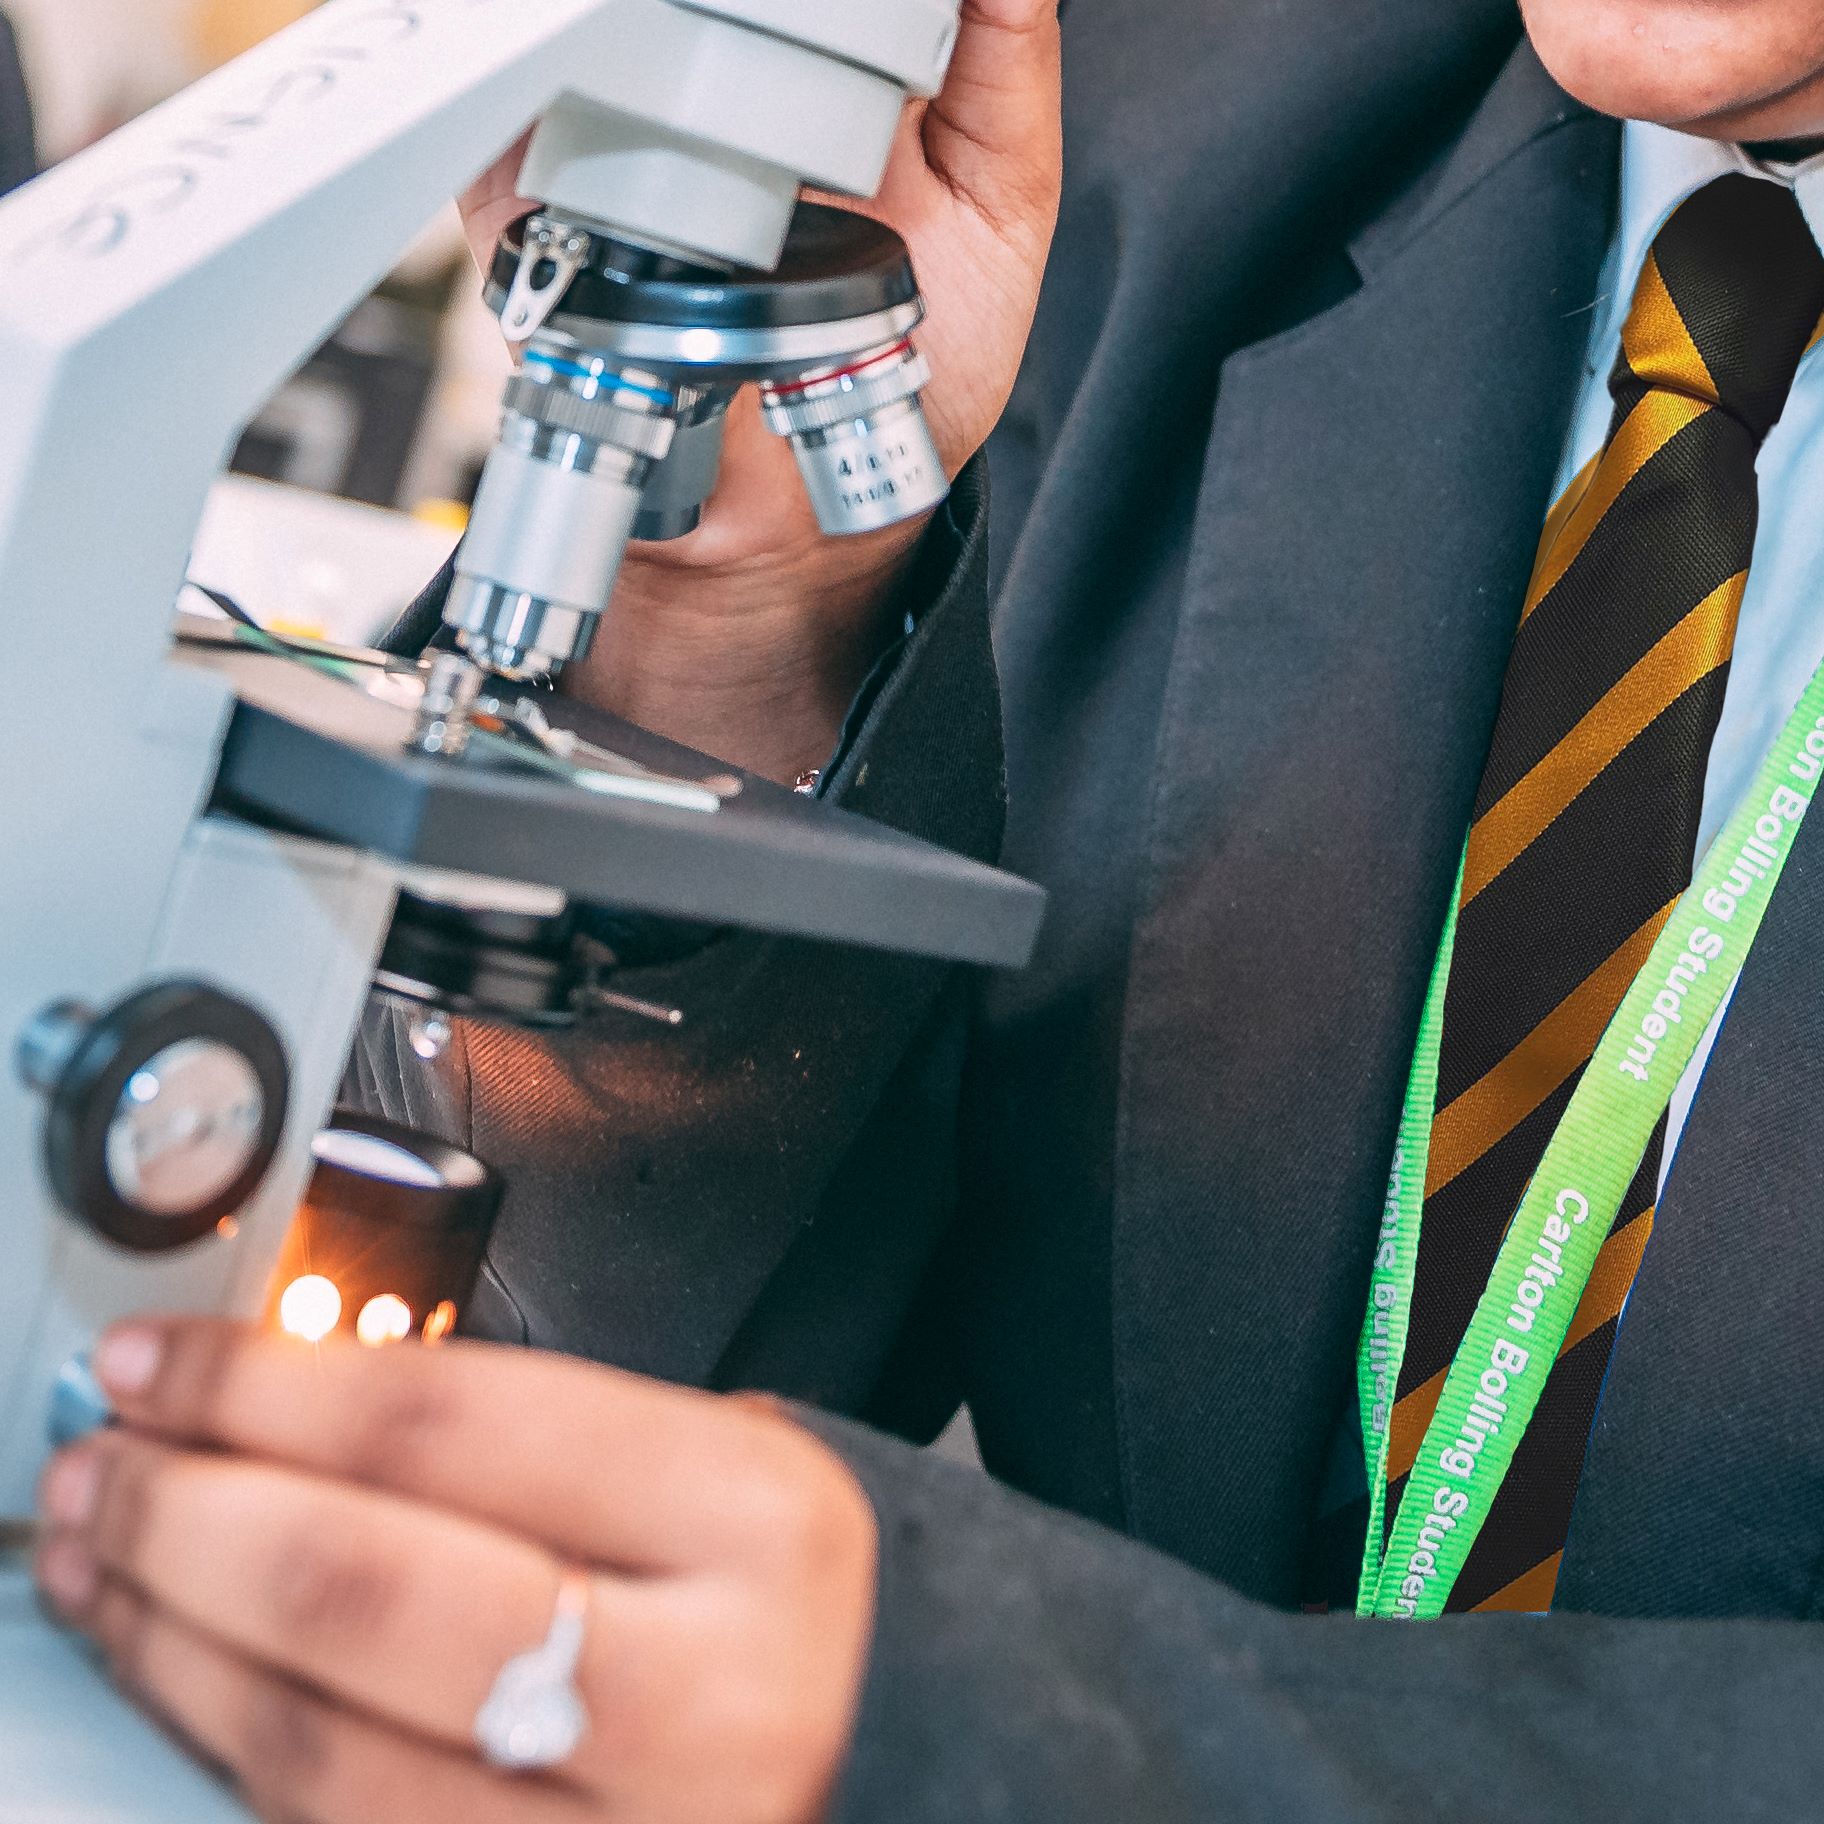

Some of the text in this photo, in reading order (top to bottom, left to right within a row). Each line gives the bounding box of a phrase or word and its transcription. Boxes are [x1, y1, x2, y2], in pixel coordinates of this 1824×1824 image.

[1701, 784, 1811, 923] Bolling
[1619, 925, 1724, 1082] Student
[1506, 1187, 1590, 1333] Carlton
[1439, 1336, 1530, 1480] Bolling
